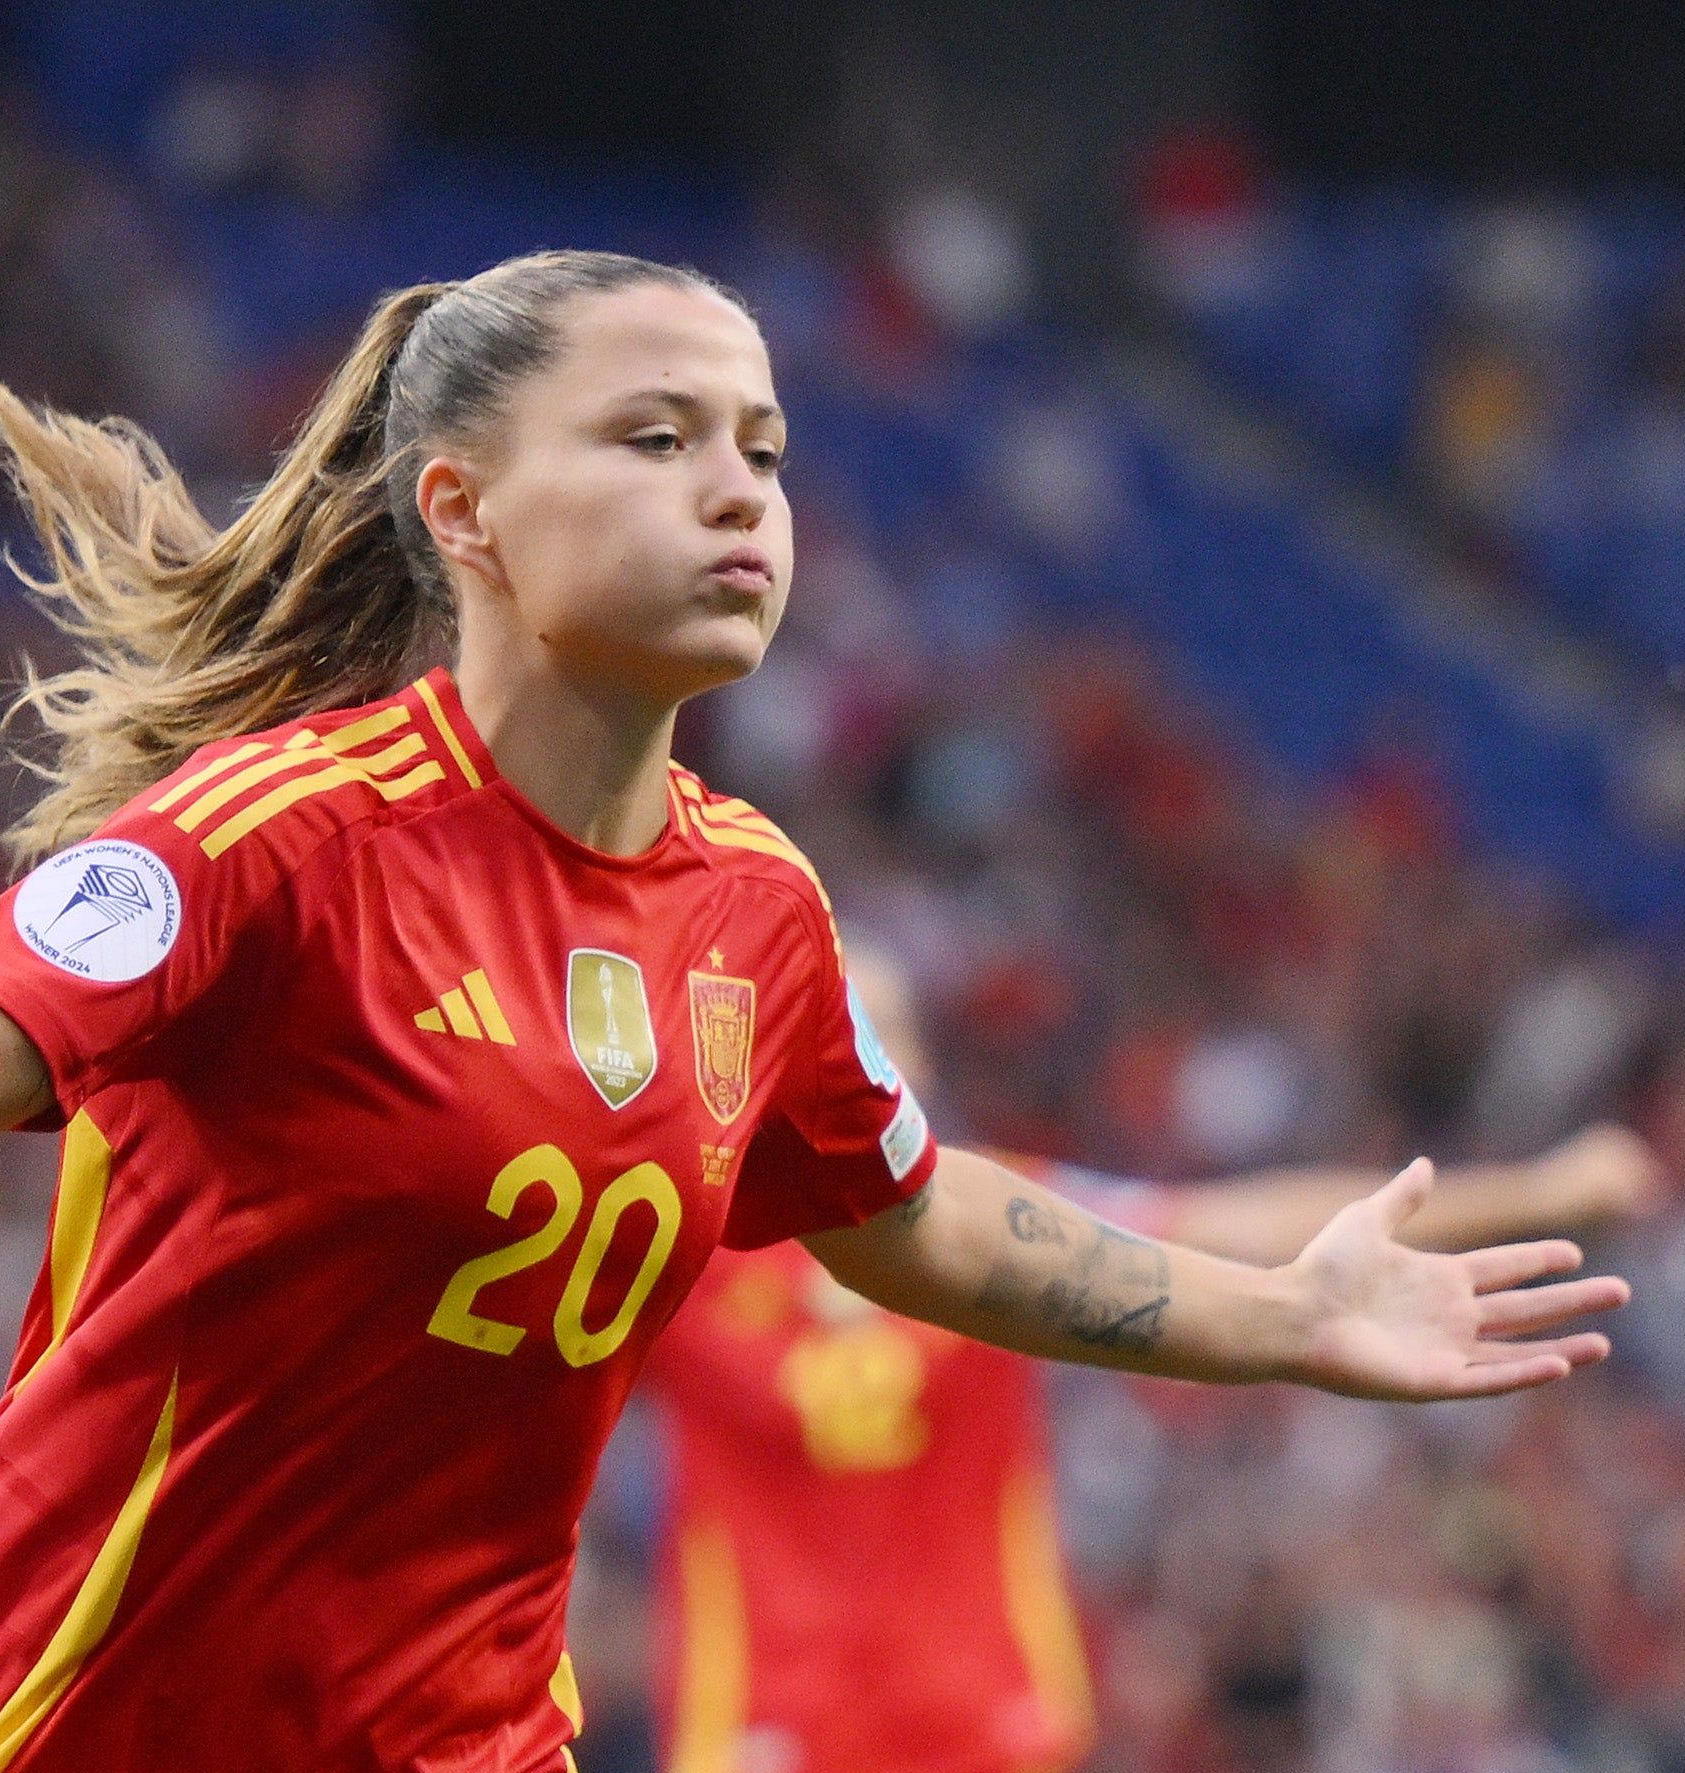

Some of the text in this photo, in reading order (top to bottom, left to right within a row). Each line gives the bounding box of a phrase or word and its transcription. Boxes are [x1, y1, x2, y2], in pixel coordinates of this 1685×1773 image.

[53, 845, 175, 945] UEFA WOMEN'S NATIONS LEAGUE
[25, 923, 91, 975] WINNER 2024
[597, 1046, 633, 1070] FIFA
[426, 1143, 682, 1368] 20
